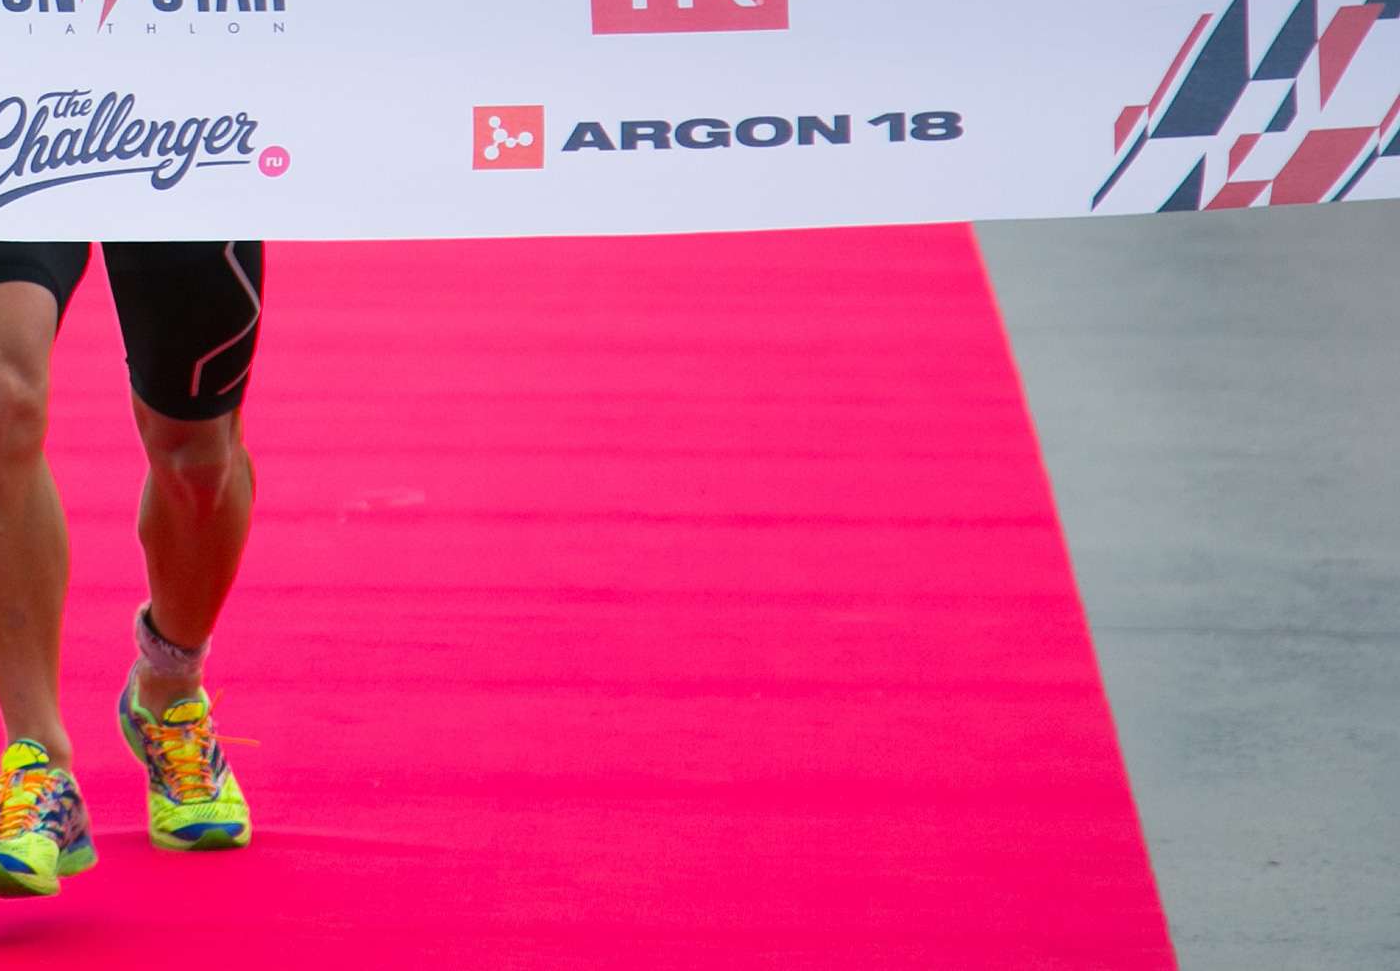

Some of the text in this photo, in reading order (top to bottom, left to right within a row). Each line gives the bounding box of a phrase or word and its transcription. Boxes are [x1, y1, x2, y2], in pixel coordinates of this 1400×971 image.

[37, 89, 93, 118] The
[561, 111, 964, 152] ARGON 18
[266, 156, 283, 168] ru
